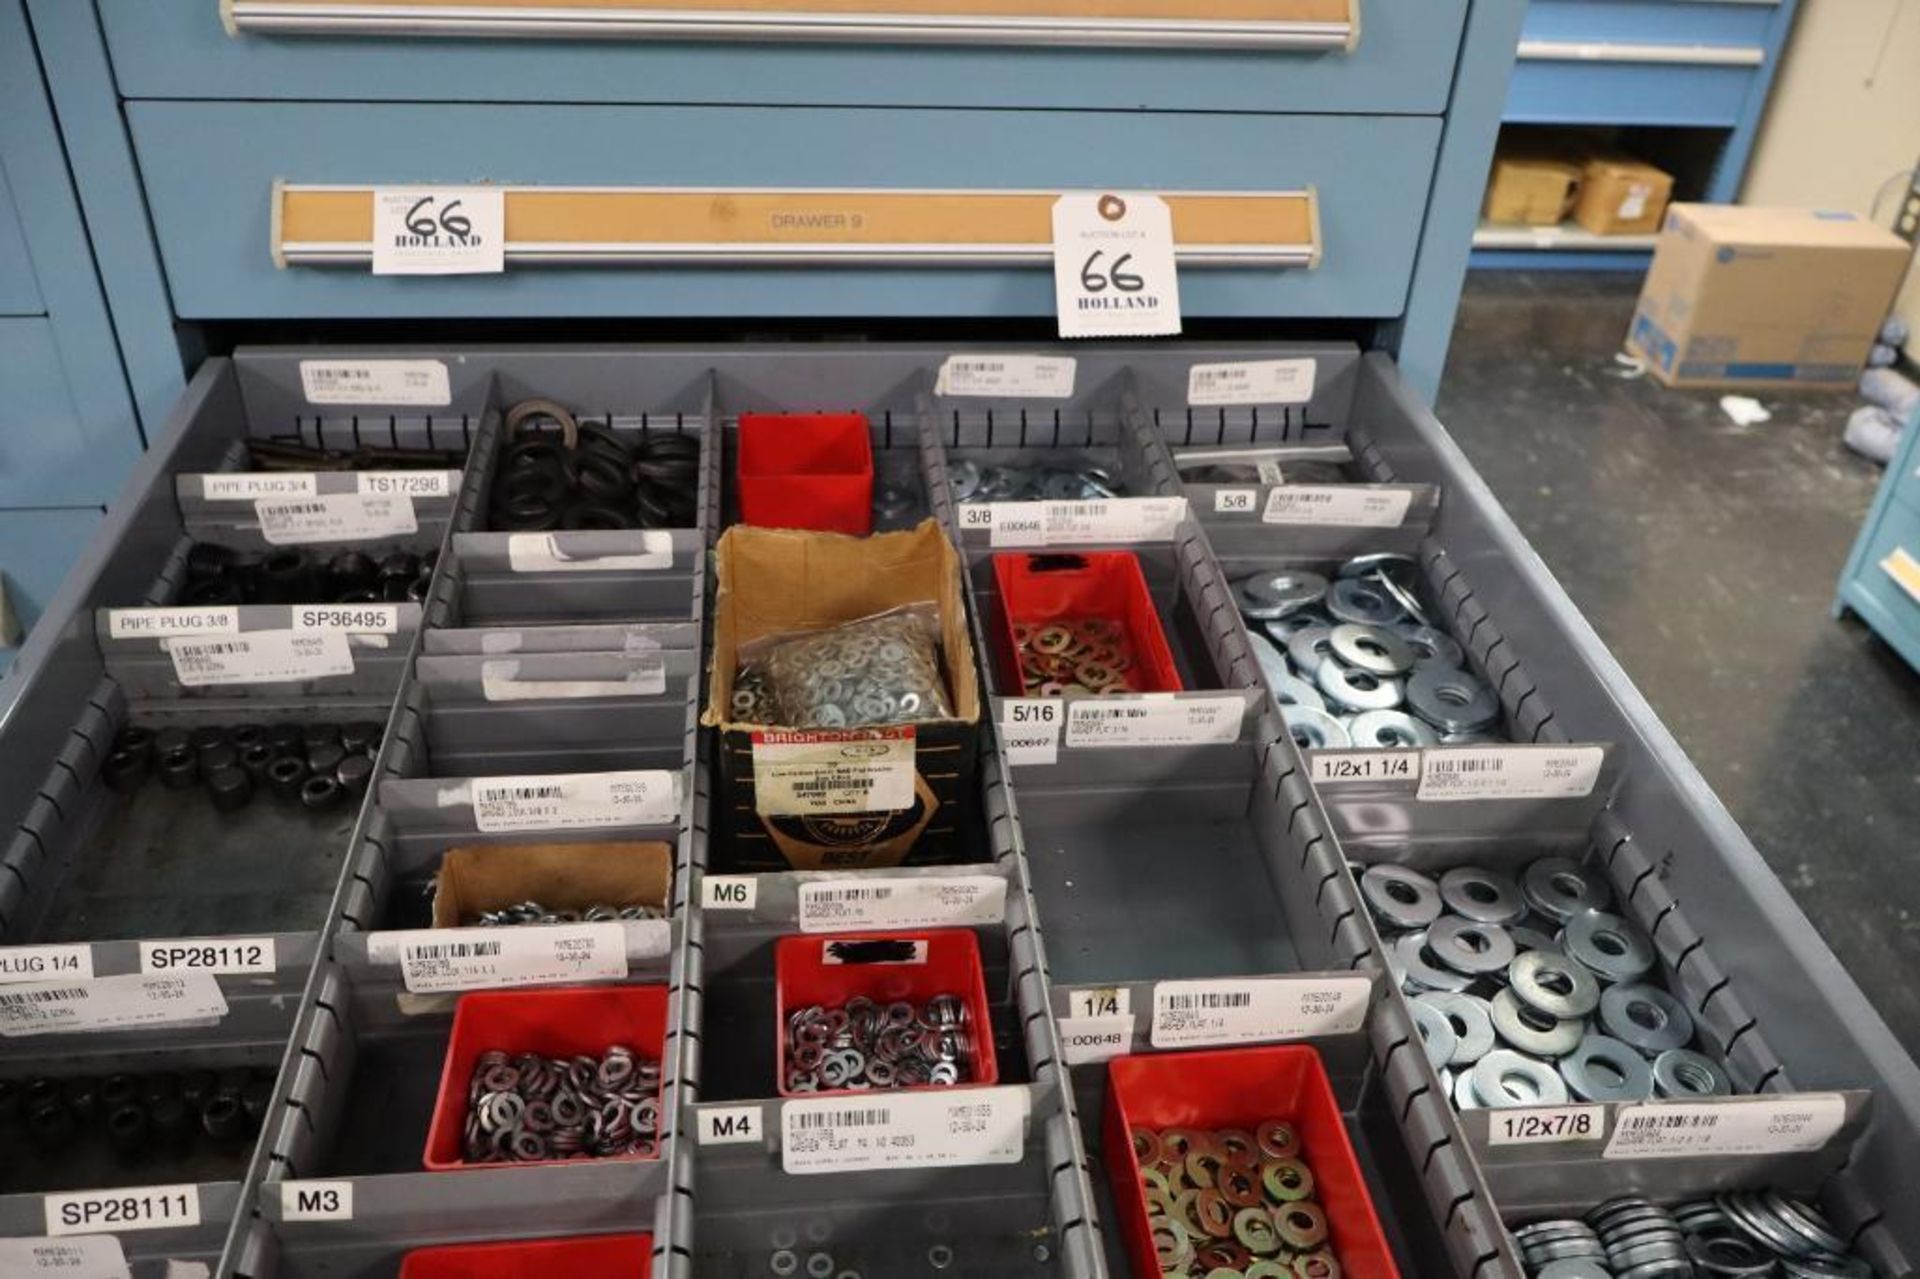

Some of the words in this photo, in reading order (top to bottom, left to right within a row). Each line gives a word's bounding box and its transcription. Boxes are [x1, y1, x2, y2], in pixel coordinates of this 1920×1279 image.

[405, 196, 471, 237] 66
[771, 213, 846, 228] DRAWER
[850, 213, 863, 228] 9
[395, 235, 482, 247] HOLLAND
[1081, 250, 1145, 293] 66
[1078, 296, 1158, 310] HOLLAND
[213, 481, 241, 494] PIPE
[247, 480, 285, 493] PLUG
[286, 480, 308, 492] 3/4
[368, 477, 440, 491] TS17298
[1223, 494, 1247, 508] 5/8
[967, 509, 992, 524] 3/8
[121, 616, 155, 631] PIPE
[160, 615, 202, 629] PLUG
[206, 614, 229, 627] 3/8
[302, 611, 387, 628] SP36495
[1013, 705, 1054, 722] 5/16
[1323, 760, 1371, 778] 1/2x1
[1381, 759, 1409, 775] 1/4
[713, 884, 747, 902] M6
[51, 955, 79, 971] 1/4
[151, 946, 262, 969] SP28112
[1084, 997, 1118, 1016] 1/4
[712, 1115, 751, 1137] M4
[1503, 1112, 1591, 1138] 1/2x7/8
[61, 1194, 188, 1225] SP28111
[297, 1190, 340, 1213] M3
